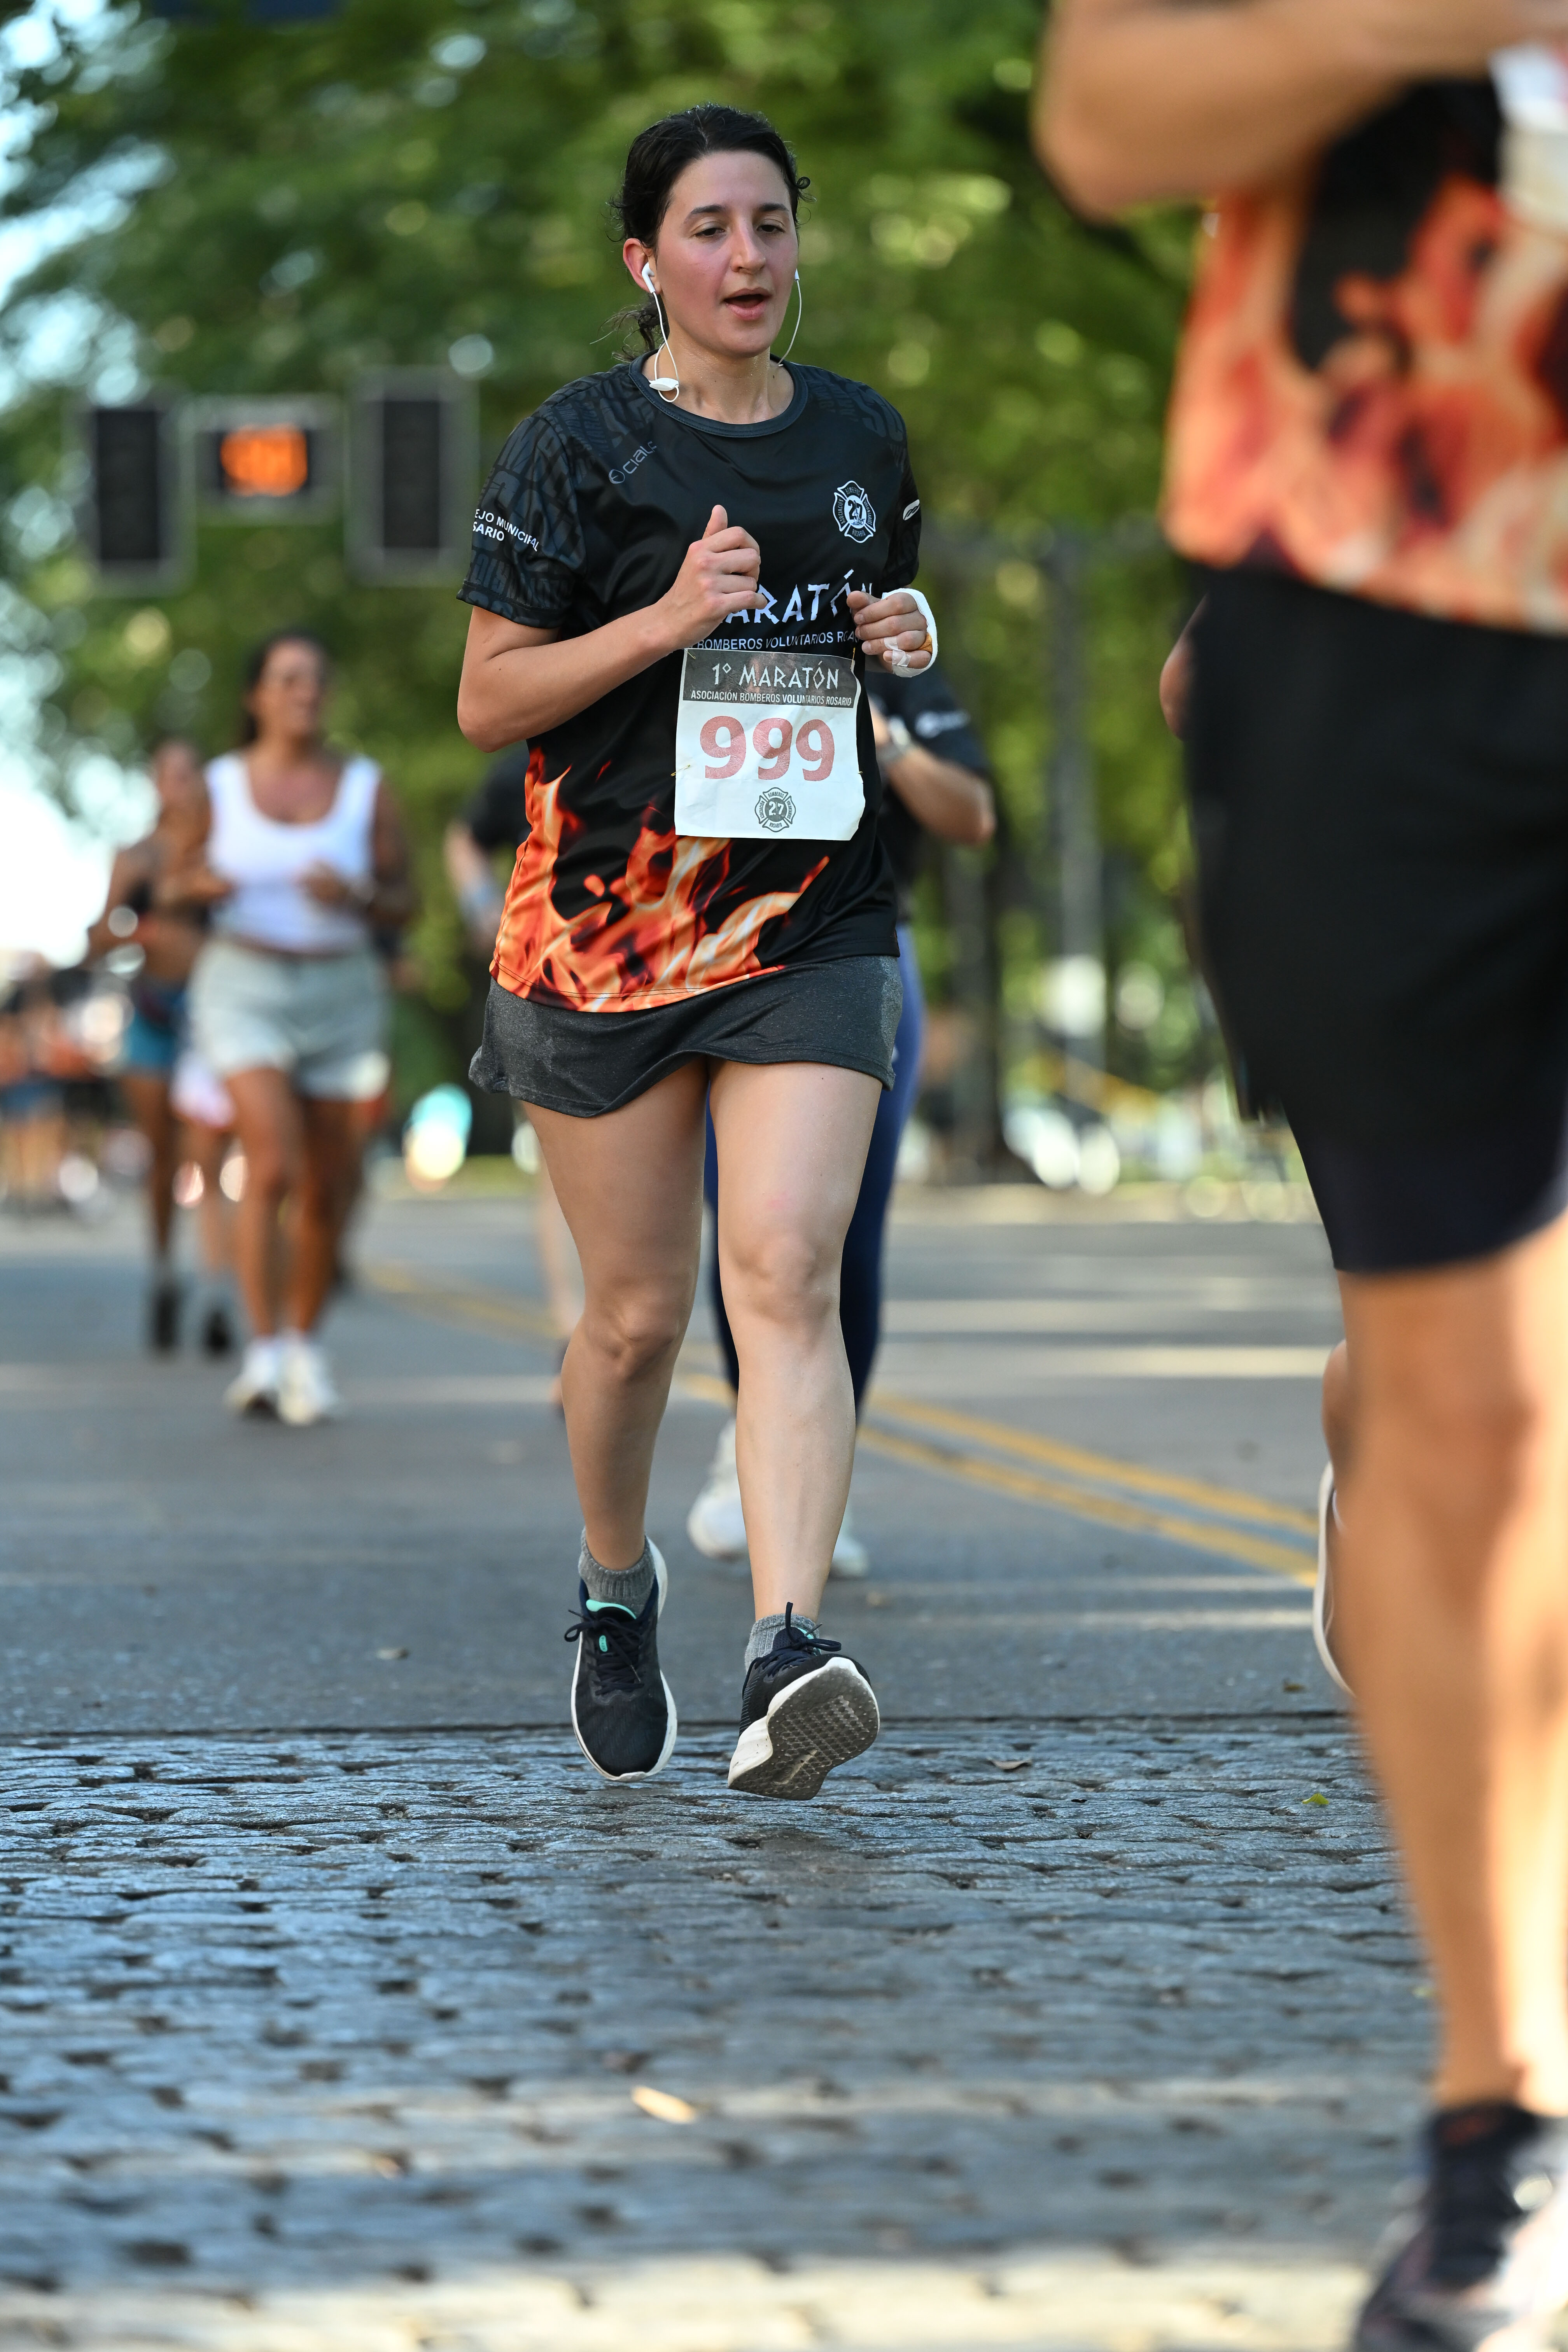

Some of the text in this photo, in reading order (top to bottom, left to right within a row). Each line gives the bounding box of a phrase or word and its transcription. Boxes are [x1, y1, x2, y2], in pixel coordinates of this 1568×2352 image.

[697, 638, 763, 650] BOMBEROS
[766, 632, 834, 649] VOLUNTARIOS
[738, 661, 839, 690] MARATÓN
[691, 690, 852, 707] ASOCIACIÓN BOMBEROS VOLUNTARIOS ROSARIO
[700, 716, 835, 782] 999
[768, 801, 784, 816] 27
